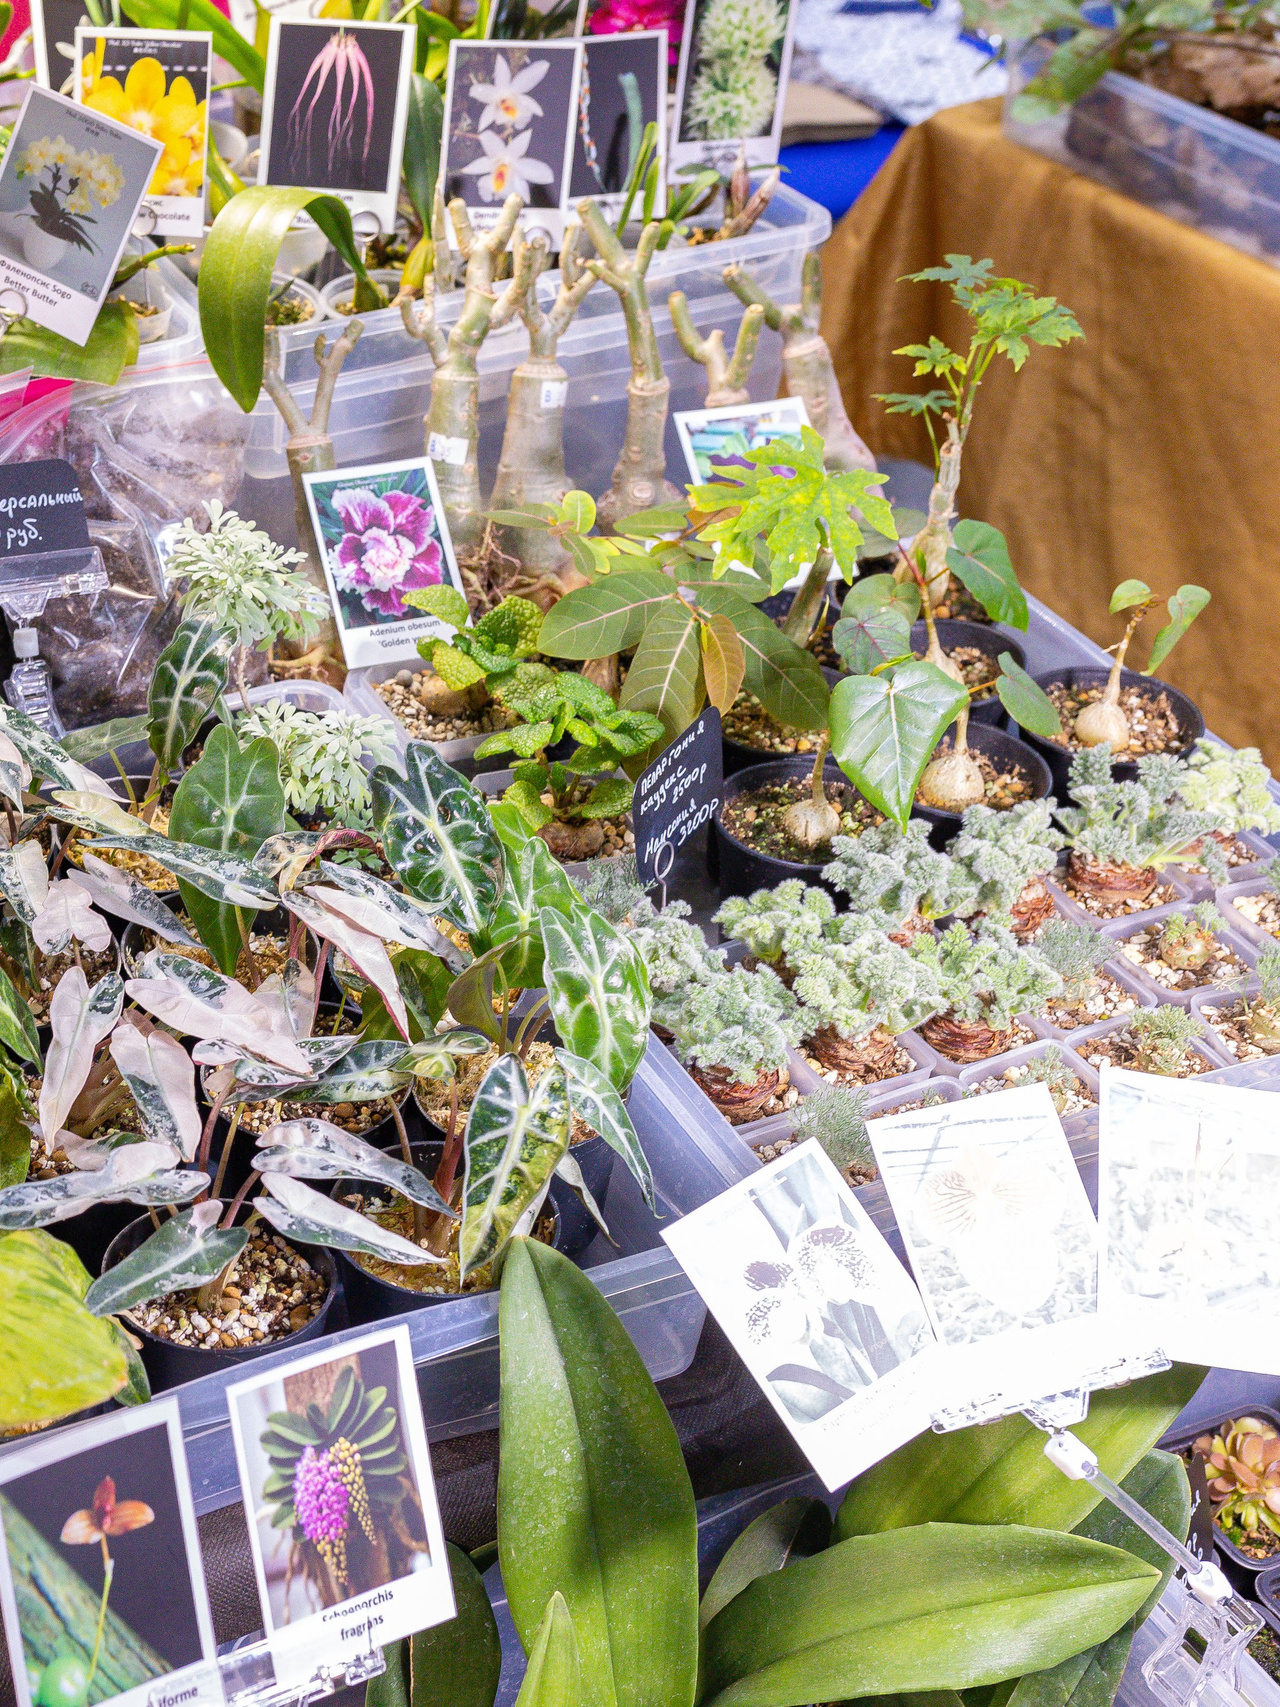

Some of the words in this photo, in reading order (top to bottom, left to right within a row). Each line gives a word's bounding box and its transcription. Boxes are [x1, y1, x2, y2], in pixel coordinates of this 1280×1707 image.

[3, 275, 31, 294] Better
[31, 288, 59, 307] Butter
[51, 284, 72, 300] Sogo
[6, 517, 43, 550] руб.
[369, 625, 407, 637] Adenium
[407, 619, 441, 631] obesum
[339, 1614, 385, 1641] fragrans
